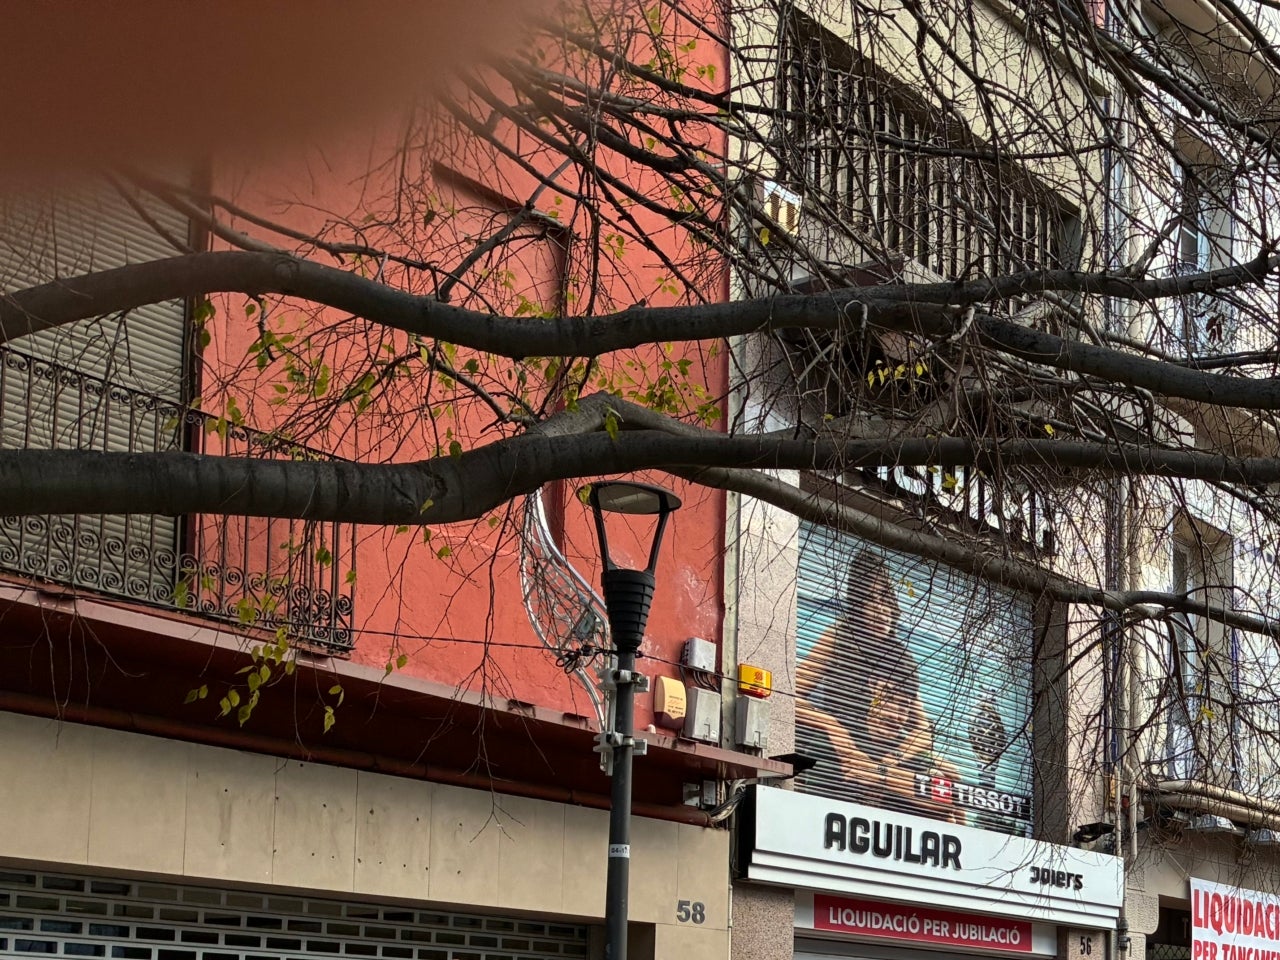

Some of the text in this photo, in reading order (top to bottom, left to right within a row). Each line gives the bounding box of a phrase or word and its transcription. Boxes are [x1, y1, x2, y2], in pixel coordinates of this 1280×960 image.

[953, 783, 1024, 817] TISSOT
[824, 812, 962, 871] AGUILAR
[677, 899, 706, 925] 58
[829, 906, 1021, 946] LIQUIDACIÓ PER JUBILACIÓ
[1080, 936, 1092, 955] 56
